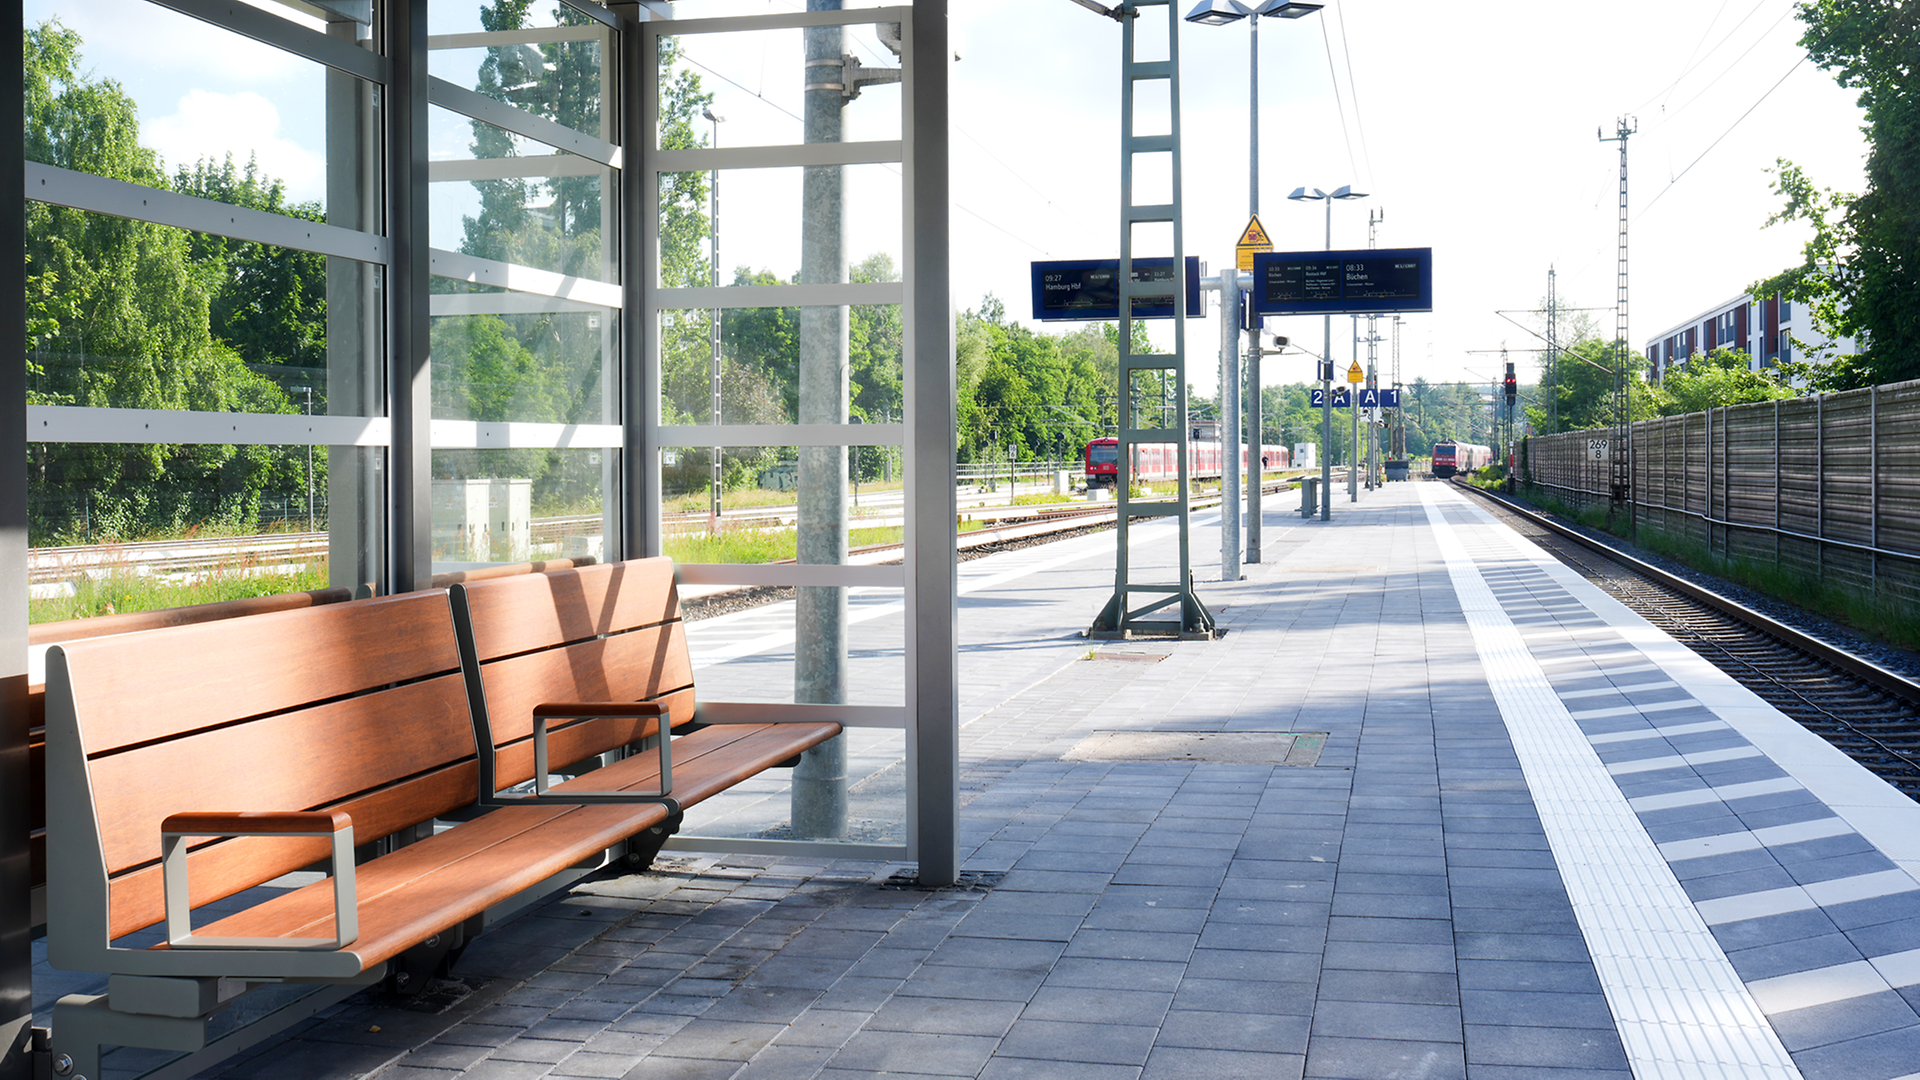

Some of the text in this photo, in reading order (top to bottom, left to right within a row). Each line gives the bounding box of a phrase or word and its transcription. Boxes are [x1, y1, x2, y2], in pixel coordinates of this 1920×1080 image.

[1045, 274, 1062, 282] 09:27
[1045, 284, 1070, 292] Hamburg
[1313, 390, 1323, 404] 2
[1364, 390, 1397, 404] A 1
[1590, 440, 1607, 449] 269
[1596, 450, 1601, 459] 8
